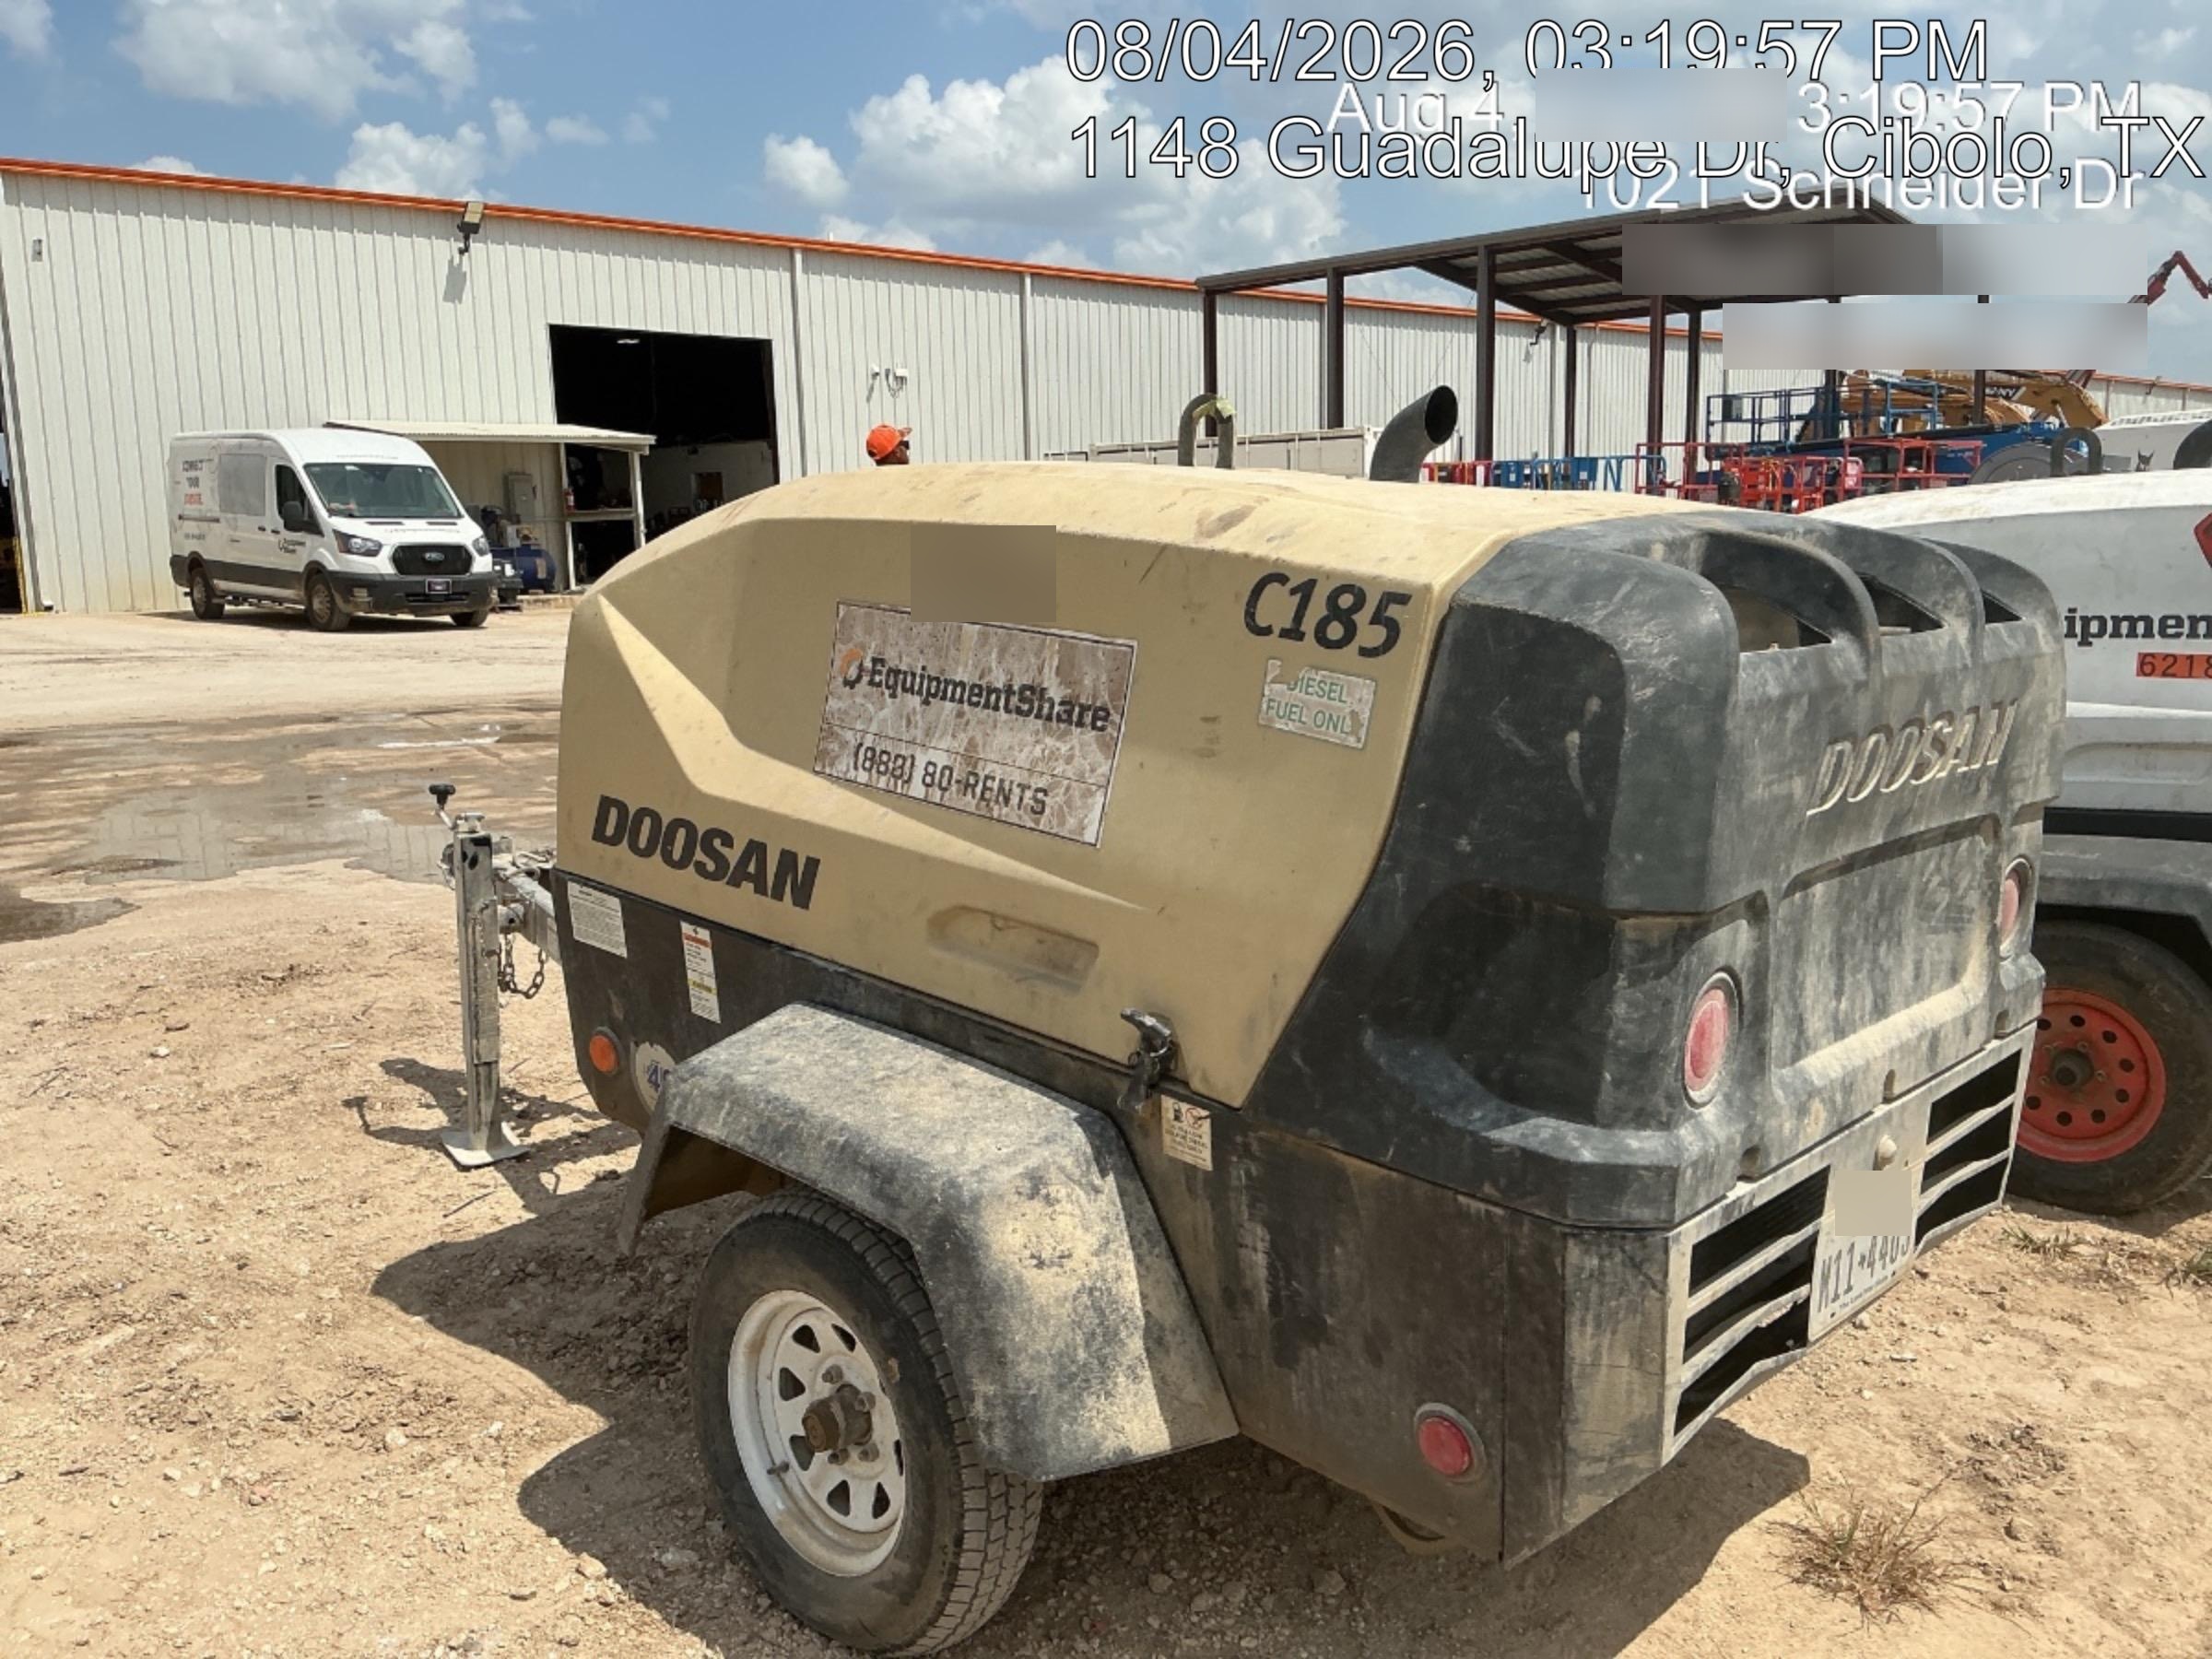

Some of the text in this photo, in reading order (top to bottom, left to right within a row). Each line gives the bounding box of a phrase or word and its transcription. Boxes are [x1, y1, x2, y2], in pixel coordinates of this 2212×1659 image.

[1243, 571, 1413, 659] C185
[867, 655, 1112, 733] EquipmentShare
[1266, 698, 1307, 724] FUEL
[853, 741, 1050, 817] (888) 80-RENTS
[1806, 698, 2019, 817] DOOSAN
[591, 794, 821, 911] DOOSAN
